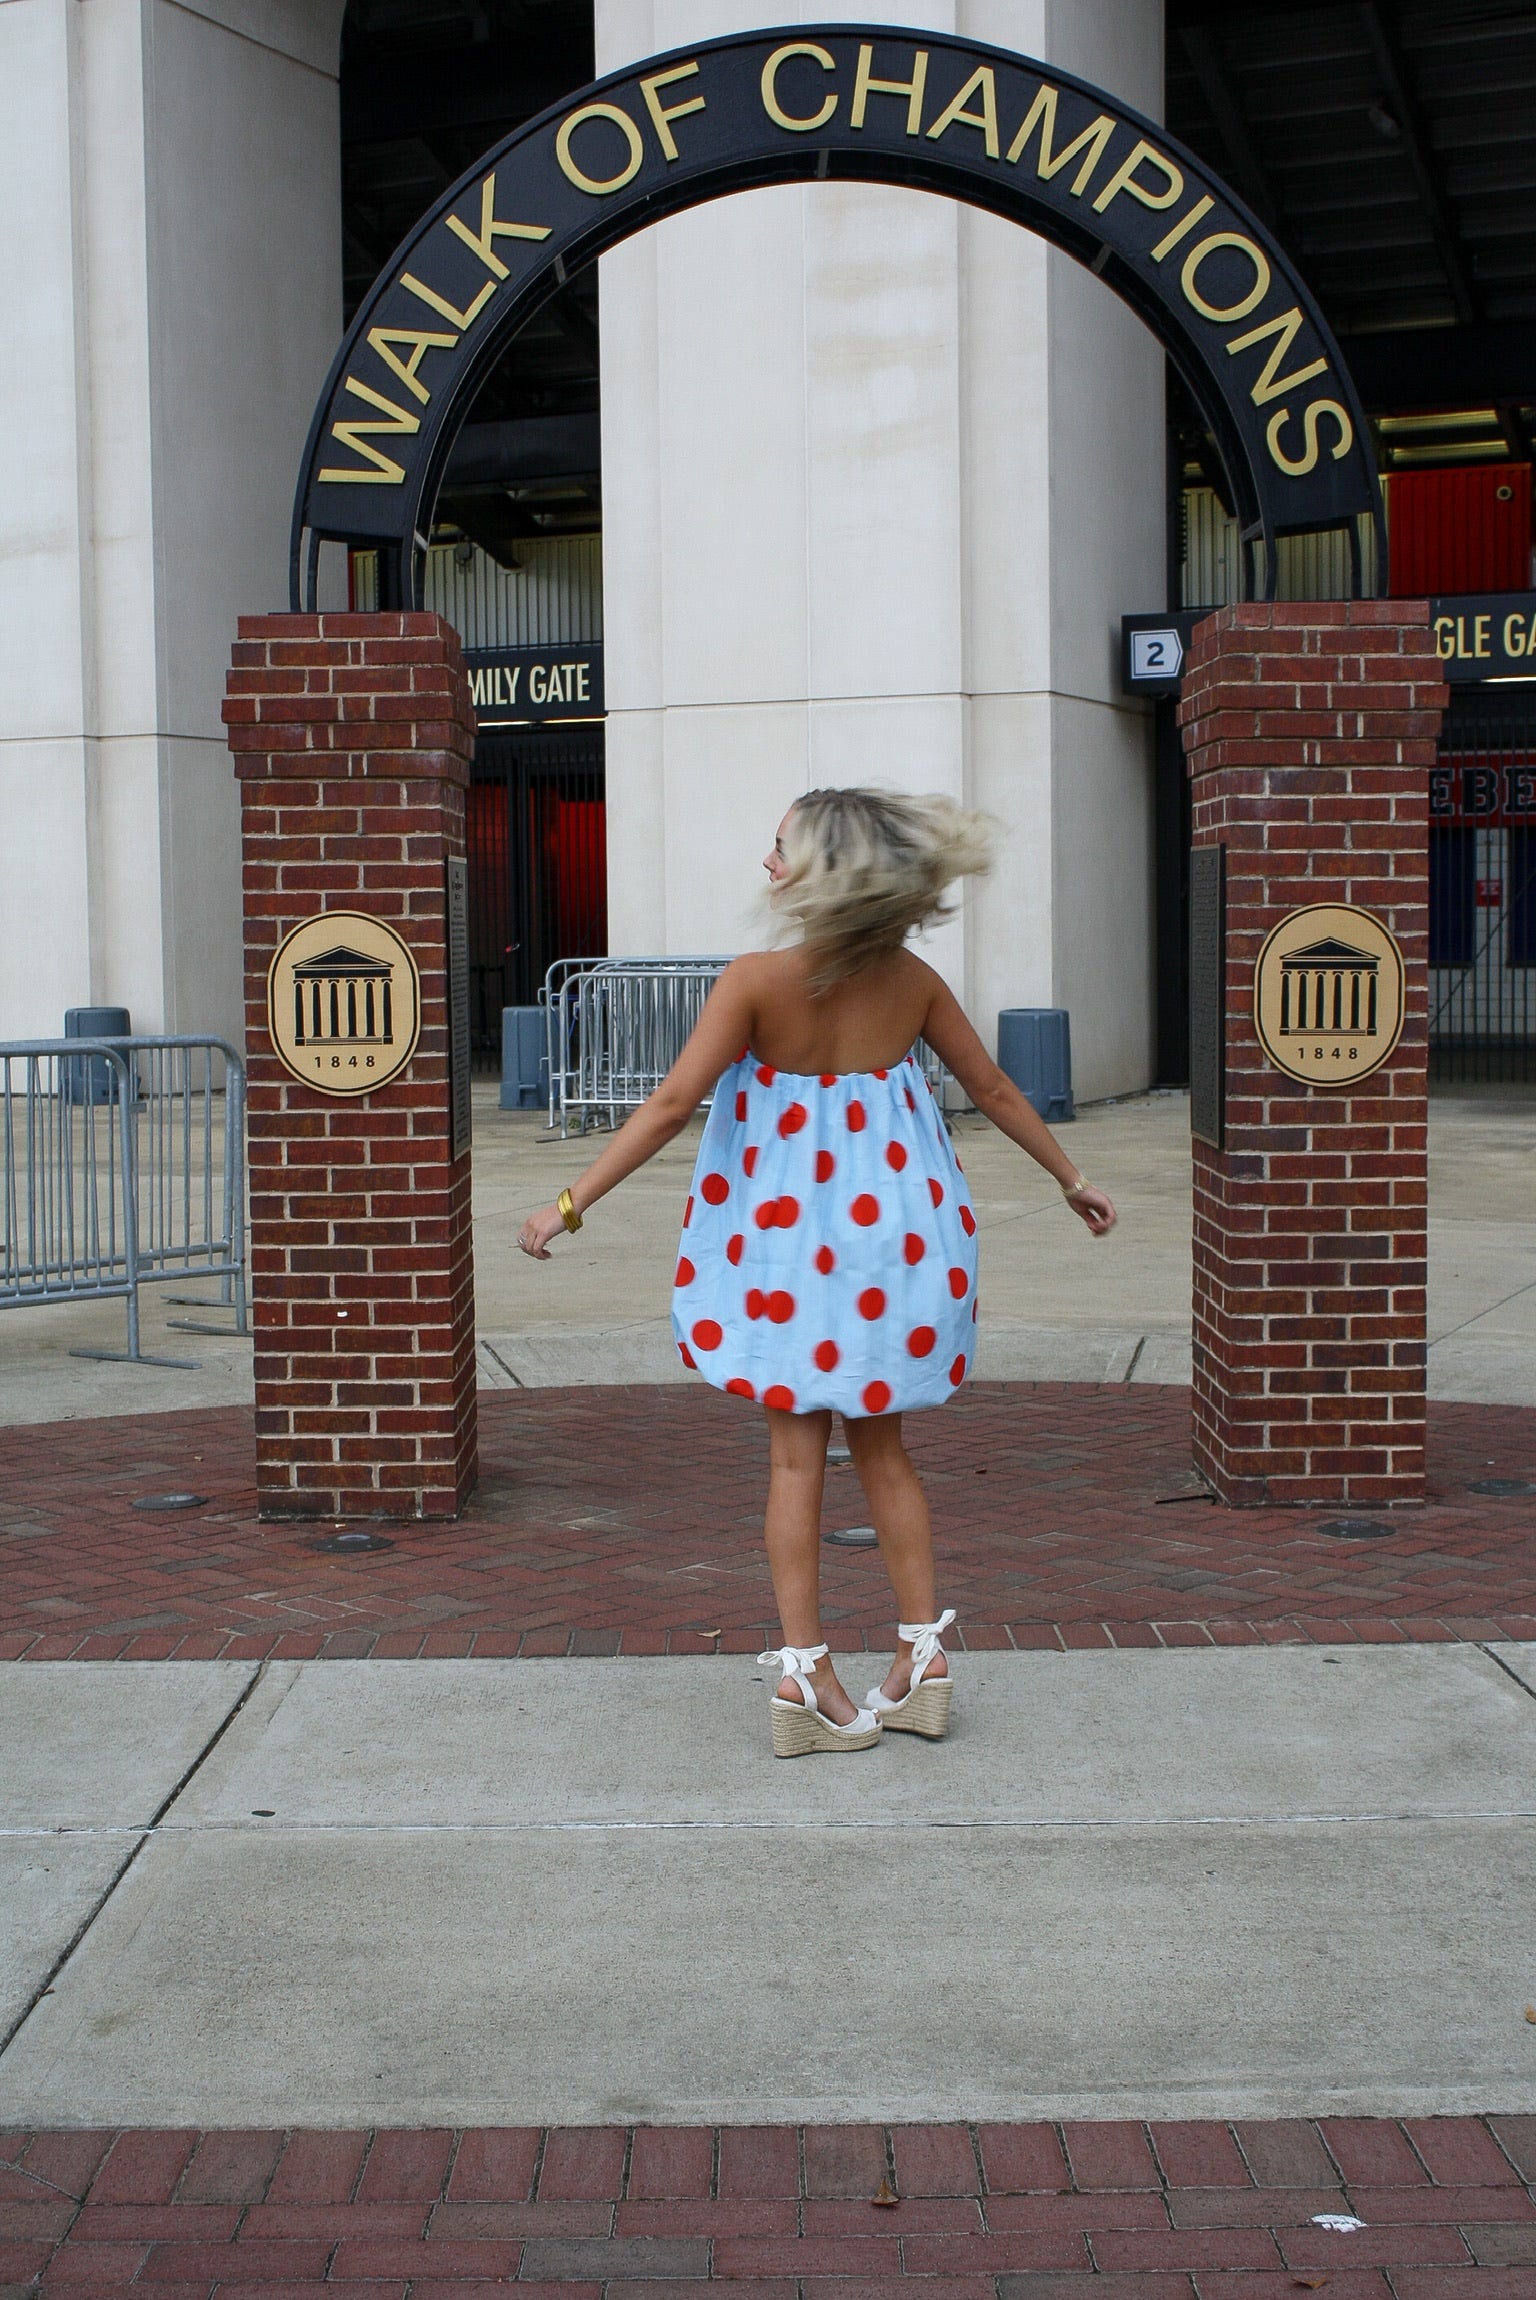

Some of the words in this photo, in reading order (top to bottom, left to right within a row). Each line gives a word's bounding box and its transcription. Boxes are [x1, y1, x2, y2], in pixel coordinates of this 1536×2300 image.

[317, 172, 553, 484] WALK
[555, 61, 706, 195] OF
[760, 43, 1354, 478] CHAMPIONS
[1146, 641, 1165, 667] 2
[529, 663, 590, 704] GATE
[314, 1055, 375, 1068] 1848
[1297, 1047, 1358, 1060] 1848
